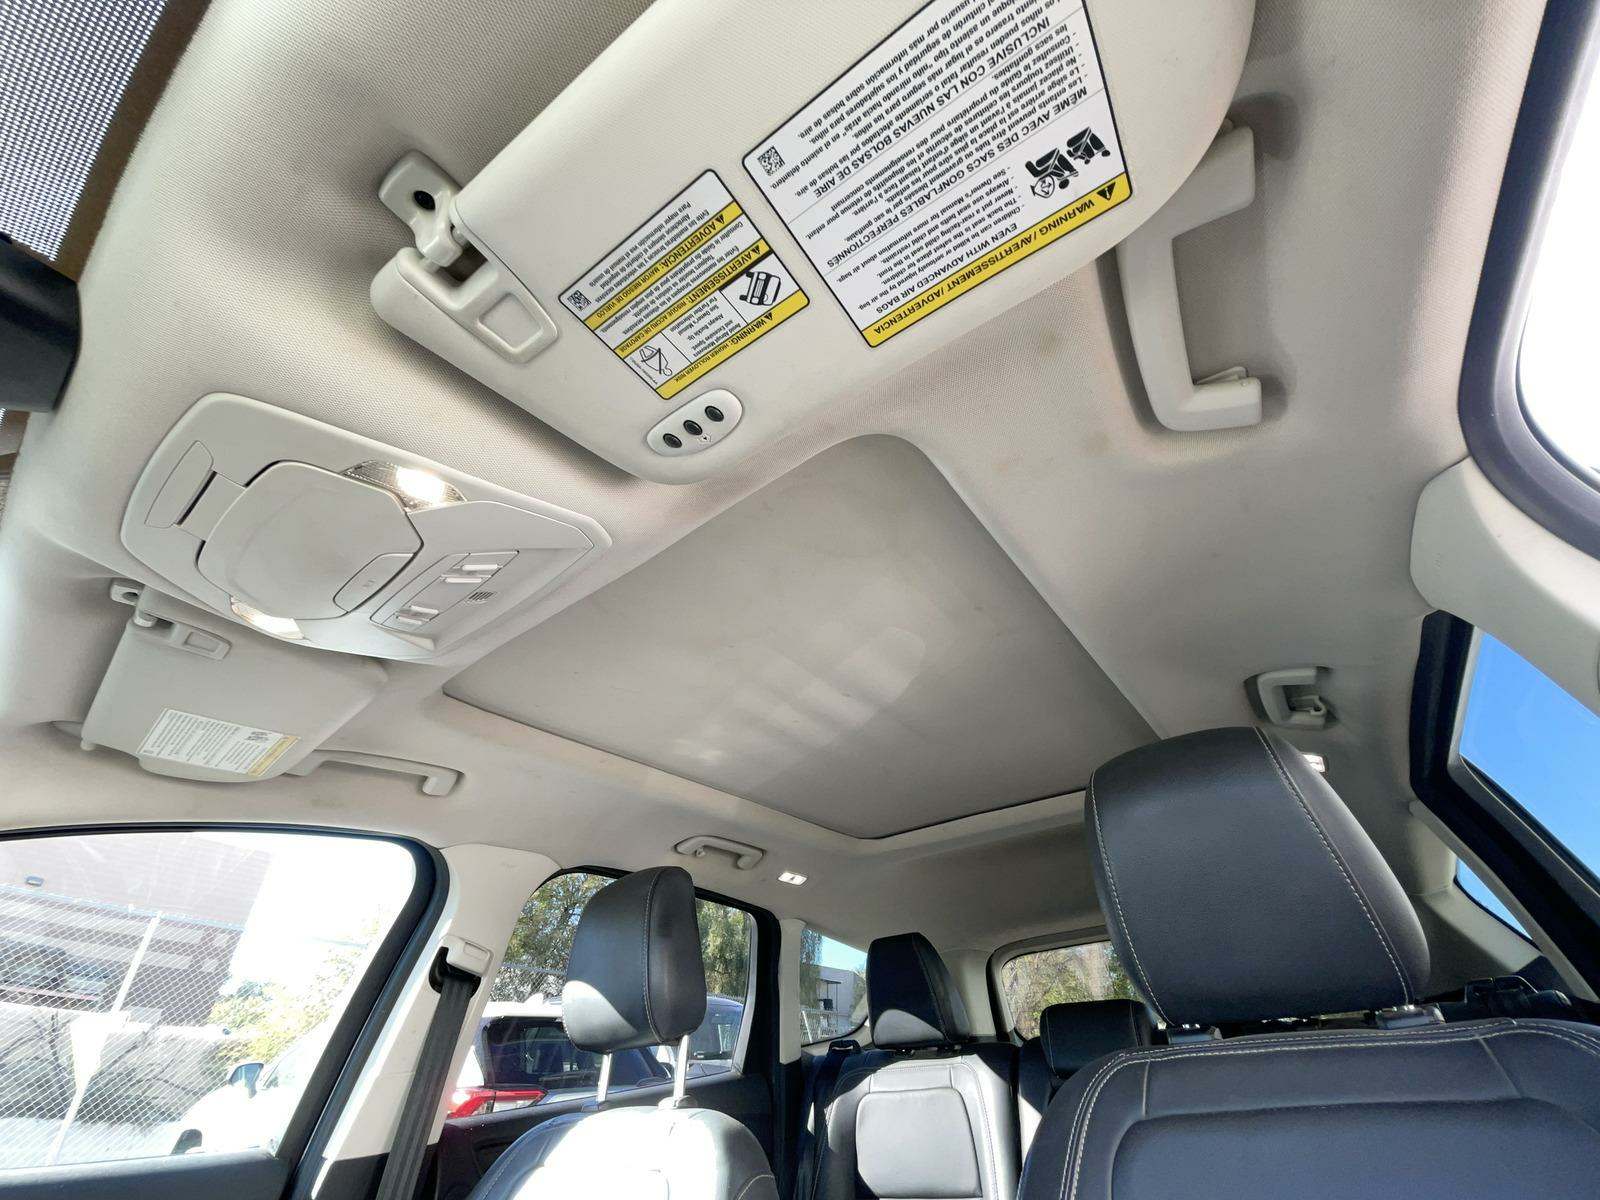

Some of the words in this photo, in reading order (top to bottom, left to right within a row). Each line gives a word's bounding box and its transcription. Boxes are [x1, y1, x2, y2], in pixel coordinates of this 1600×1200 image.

[979, 14, 991, 27] un
[1020, 5, 1043, 28] niños
[949, 23, 979, 52] asiento
[988, 21, 1020, 51] pueden
[1054, 22, 1068, 38] les
[986, 14, 1050, 69] INCLUSIVE
[1031, 33, 1071, 67] Consultez
[1034, 33, 1053, 51] sacs
[932, 45, 950, 64] tipo
[958, 46, 989, 75] resultar
[1043, 44, 1074, 71] Utilisez
[959, 63, 986, 89] CON
[1022, 62, 1031, 73] le
[939, 69, 958, 88] fatal
[999, 68, 1022, 90] Guide
[1010, 64, 1043, 94] toujours
[1067, 75, 1083, 91] Les
[881, 76, 912, 104] mirando
[933, 83, 940, 92] o
[935, 83, 959, 107] LAS
[988, 85, 1000, 98] du
[998, 89, 1011, 103] les
[893, 88, 934, 123] seriamente
[1037, 86, 1067, 111] enfants
[1052, 84, 1088, 117] MÊME
[861, 99, 883, 119] hacia
[945, 92, 988, 129] propriétaire
[963, 98, 998, 127] ceintures
[891, 101, 935, 139] NUEVAS
[1006, 105, 1037, 132] peuvent
[1020, 109, 1051, 136] AVEC
[830, 132, 841, 143] en
[860, 119, 894, 149] afectados
[928, 123, 946, 140] pour
[953, 123, 964, 135] de
[990, 127, 1007, 143] être
[823, 139, 832, 150] el
[848, 143, 861, 156] por
[915, 136, 929, 151] des
[924, 130, 953, 155] sécurité
[974, 138, 991, 154] tués
[995, 131, 1019, 152] DES
[799, 145, 824, 168] asiento
[837, 153, 850, 166] las
[850, 133, 892, 170] BOLSAS
[916, 151, 925, 161] et
[963, 149, 974, 160] ou
[965, 147, 995, 173] SACS
[863, 145, 916, 187] renseignements
[905, 156, 917, 169] les
[927, 155, 964, 185] gravement
[816, 161, 839, 182] bolsas
[835, 164, 852, 181] DE
[871, 163, 906, 193] dispositifs
[992, 167, 1006, 181] See
[808, 177, 818, 188] de
[812, 176, 837, 198] AIRE
[964, 177, 992, 199] Owner's
[984, 176, 1010, 198] Always
[829, 183, 865, 213] concernant
[862, 188, 873, 199] de
[898, 168, 965, 218] GONFLABLES
[903, 181, 929, 203] blessés
[971, 194, 984, 205] use
[993, 186, 1014, 204] Never
[839, 195, 864, 216] retenue
[884, 206, 892, 215] le
[891, 197, 903, 209] par
[939, 195, 964, 216] Manual
[956, 202, 972, 216] seat
[980, 198, 993, 212] put
[1003, 196, 1017, 209] The
[824, 211, 840, 225] pour
[872, 211, 885, 223] sac
[929, 212, 940, 223] for
[939, 212, 957, 227] belts
[986, 205, 1003, 220] back
[992, 205, 1021, 227] Children
[1038, 196, 1094, 236] WARNING
[912, 218, 929, 233] more
[926, 223, 940, 236] and
[939, 210, 975, 238] rear-facing
[963, 225, 971, 234] is
[971, 216, 986, 229] seat
[979, 222, 992, 234] can
[910, 231, 927, 246] child
[952, 230, 964, 241] the
[970, 230, 980, 241] be
[990, 221, 1018, 243] EVEN
[658, 220, 718, 271] ADVERTENCIA:
[825, 213, 900, 269] PERFECTIONNÉS
[877, 230, 913, 257] information
[923, 234, 940, 248] child
[932, 237, 953, 254] safest
[951, 236, 971, 252] killed
[964, 238, 990, 258] WITH
[903, 253, 911, 262] in
[909, 244, 925, 257] seat
[915, 249, 933, 264] place
[944, 248, 952, 256] or
[860, 253, 878, 268] about
[892, 258, 904, 268] the
[906, 261, 916, 270] for
[916, 252, 945, 274] seriously
[685, 250, 754, 304] AVERTISSEMENT:
[851, 265, 861, 274] air
[895, 269, 918, 287] injured
[915, 254, 965, 289] ADVANCED
[878, 288, 889, 298] the
[887, 282, 897, 292] by
[899, 284, 916, 298] AIR
[869, 295, 879, 304] air
[874, 294, 900, 314] BAGS
[727, 317, 767, 347] WARNING:
